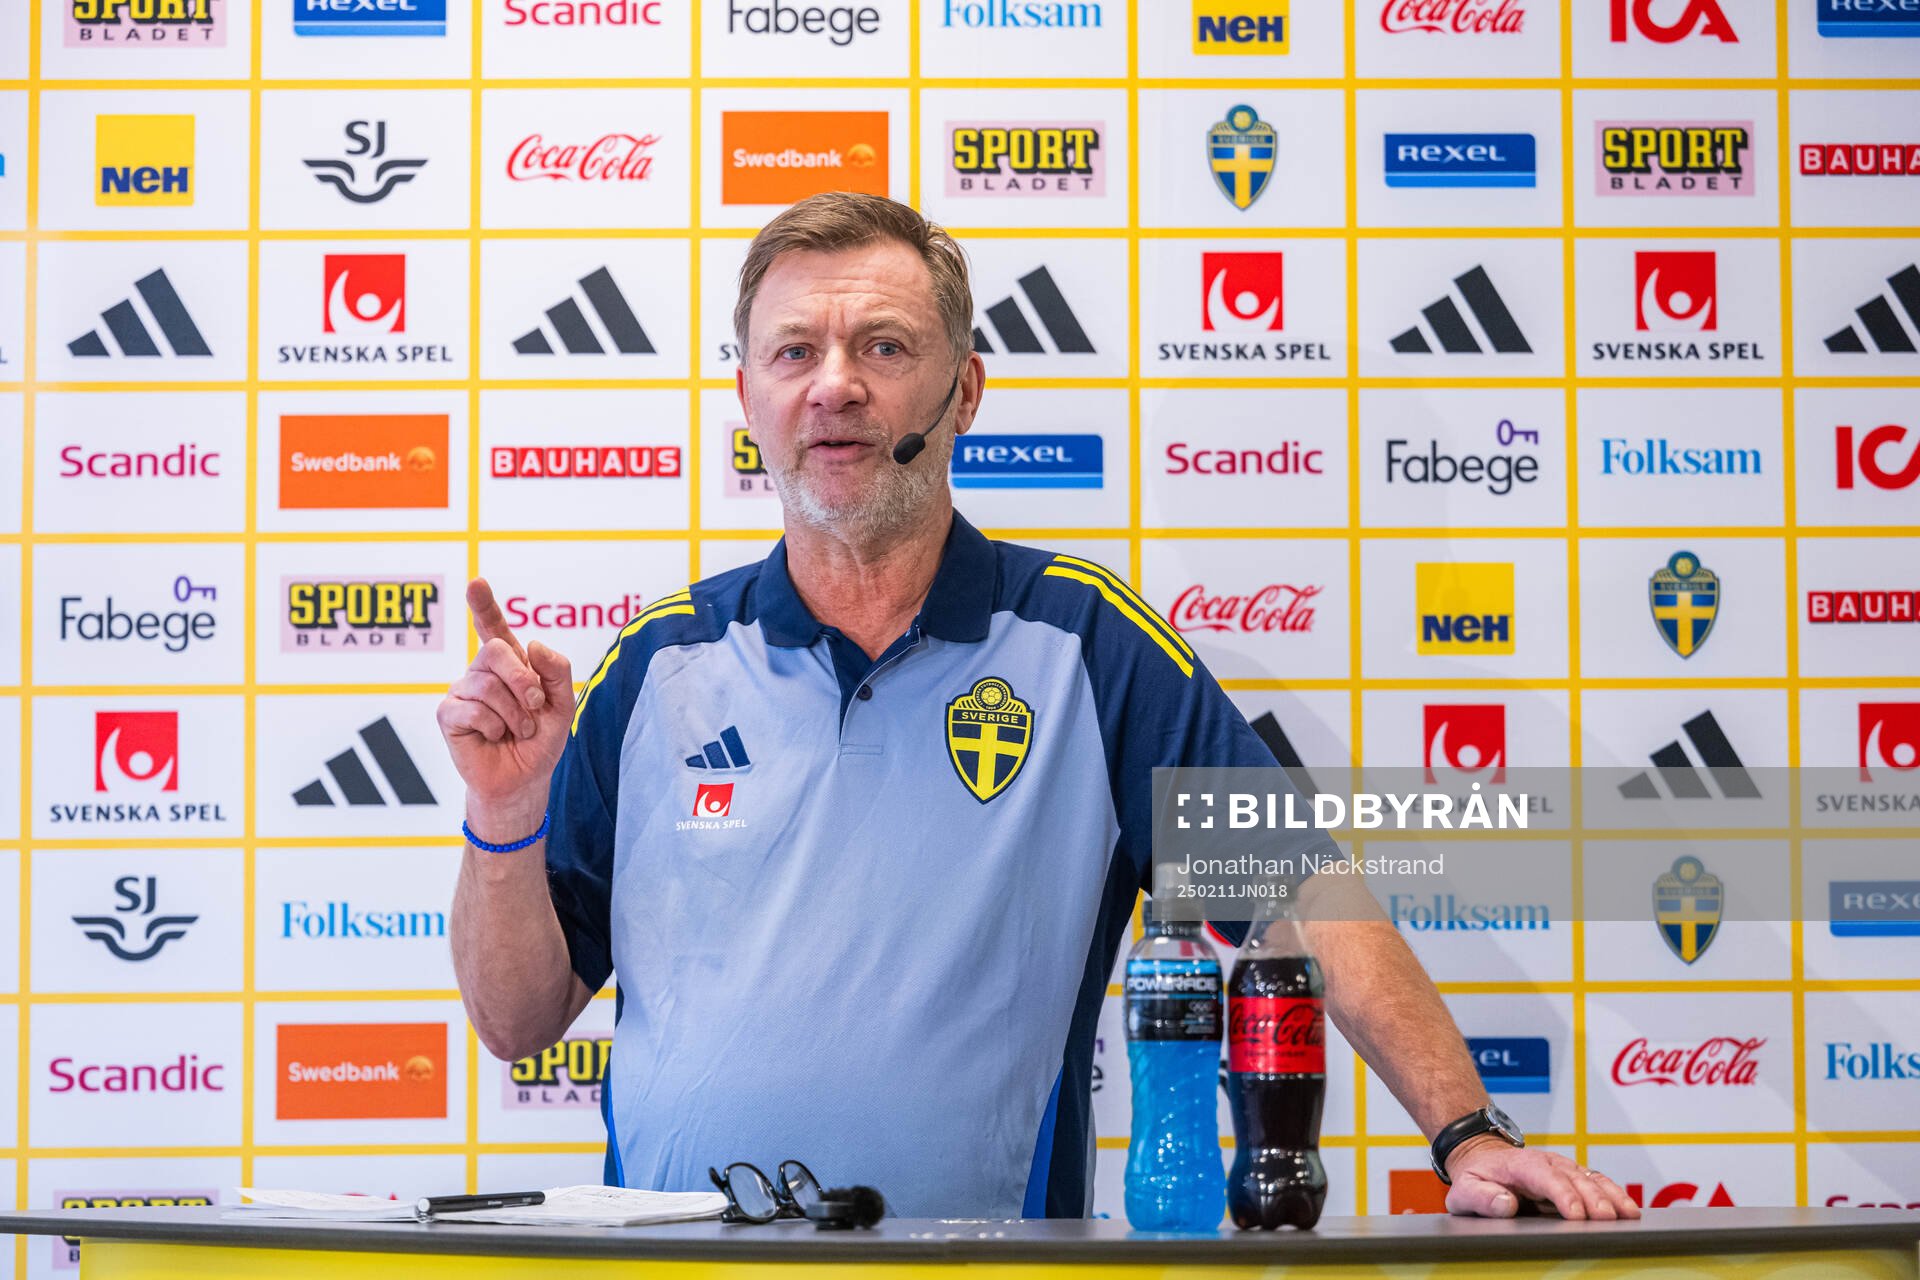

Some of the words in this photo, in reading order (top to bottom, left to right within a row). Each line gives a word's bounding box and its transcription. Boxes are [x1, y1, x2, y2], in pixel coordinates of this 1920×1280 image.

[505, 0, 660, 25] Scandic
[730, 0, 879, 46] Fabege
[942, 0, 1102, 28] Folksam
[1381, 0, 1524, 33] Coca-Cola
[1610, 0, 1739, 43] ICA
[80, 28, 212, 40] BLADET
[345, 121, 386, 158] SJ
[953, 128, 1099, 174] SPORT
[1602, 127, 1749, 175] SPORT
[506, 135, 656, 180] Coca-Cola
[733, 149, 841, 167] Swedbank
[1803, 147, 1920, 171] BAUHA
[961, 177, 1092, 191] BLADET
[1611, 177, 1742, 190] BLADET
[280, 346, 387, 362] SVENSKA
[397, 346, 451, 362] SPEL
[1160, 344, 1266, 360] SVENSKA
[1275, 344, 1330, 360] SPEL
[1594, 343, 1700, 360] SVENSKA
[1709, 343, 1763, 359] SPEL
[61, 444, 219, 477] Scandic
[292, 452, 400, 471] Swedbank
[493, 448, 680, 474] BAUHAUS
[1167, 441, 1322, 474] Scandic
[1387, 439, 1538, 495] Fabege
[1603, 439, 1761, 474] Folksam
[289, 582, 437, 629] SPORT
[505, 594, 641, 628] Scandi
[1169, 584, 1323, 634] Coca-Cola
[1811, 594, 1920, 618] BAUH
[61, 597, 216, 652] Fabege
[297, 632, 430, 645] BLADET
[961, 711, 1019, 724] SVERIGE
[51, 805, 159, 822] SVENSKA
[170, 805, 224, 821] SPEL
[676, 820, 720, 831] SVENSKA
[722, 818, 748, 830] SPEL
[114, 876, 157, 914] SJ
[284, 903, 444, 938] Folksam
[50, 1055, 223, 1092] Scandic
[289, 1062, 399, 1082] Swedbank
[1612, 1038, 1766, 1086] Coca-Cola
[1827, 1043, 1920, 1079] Folks
